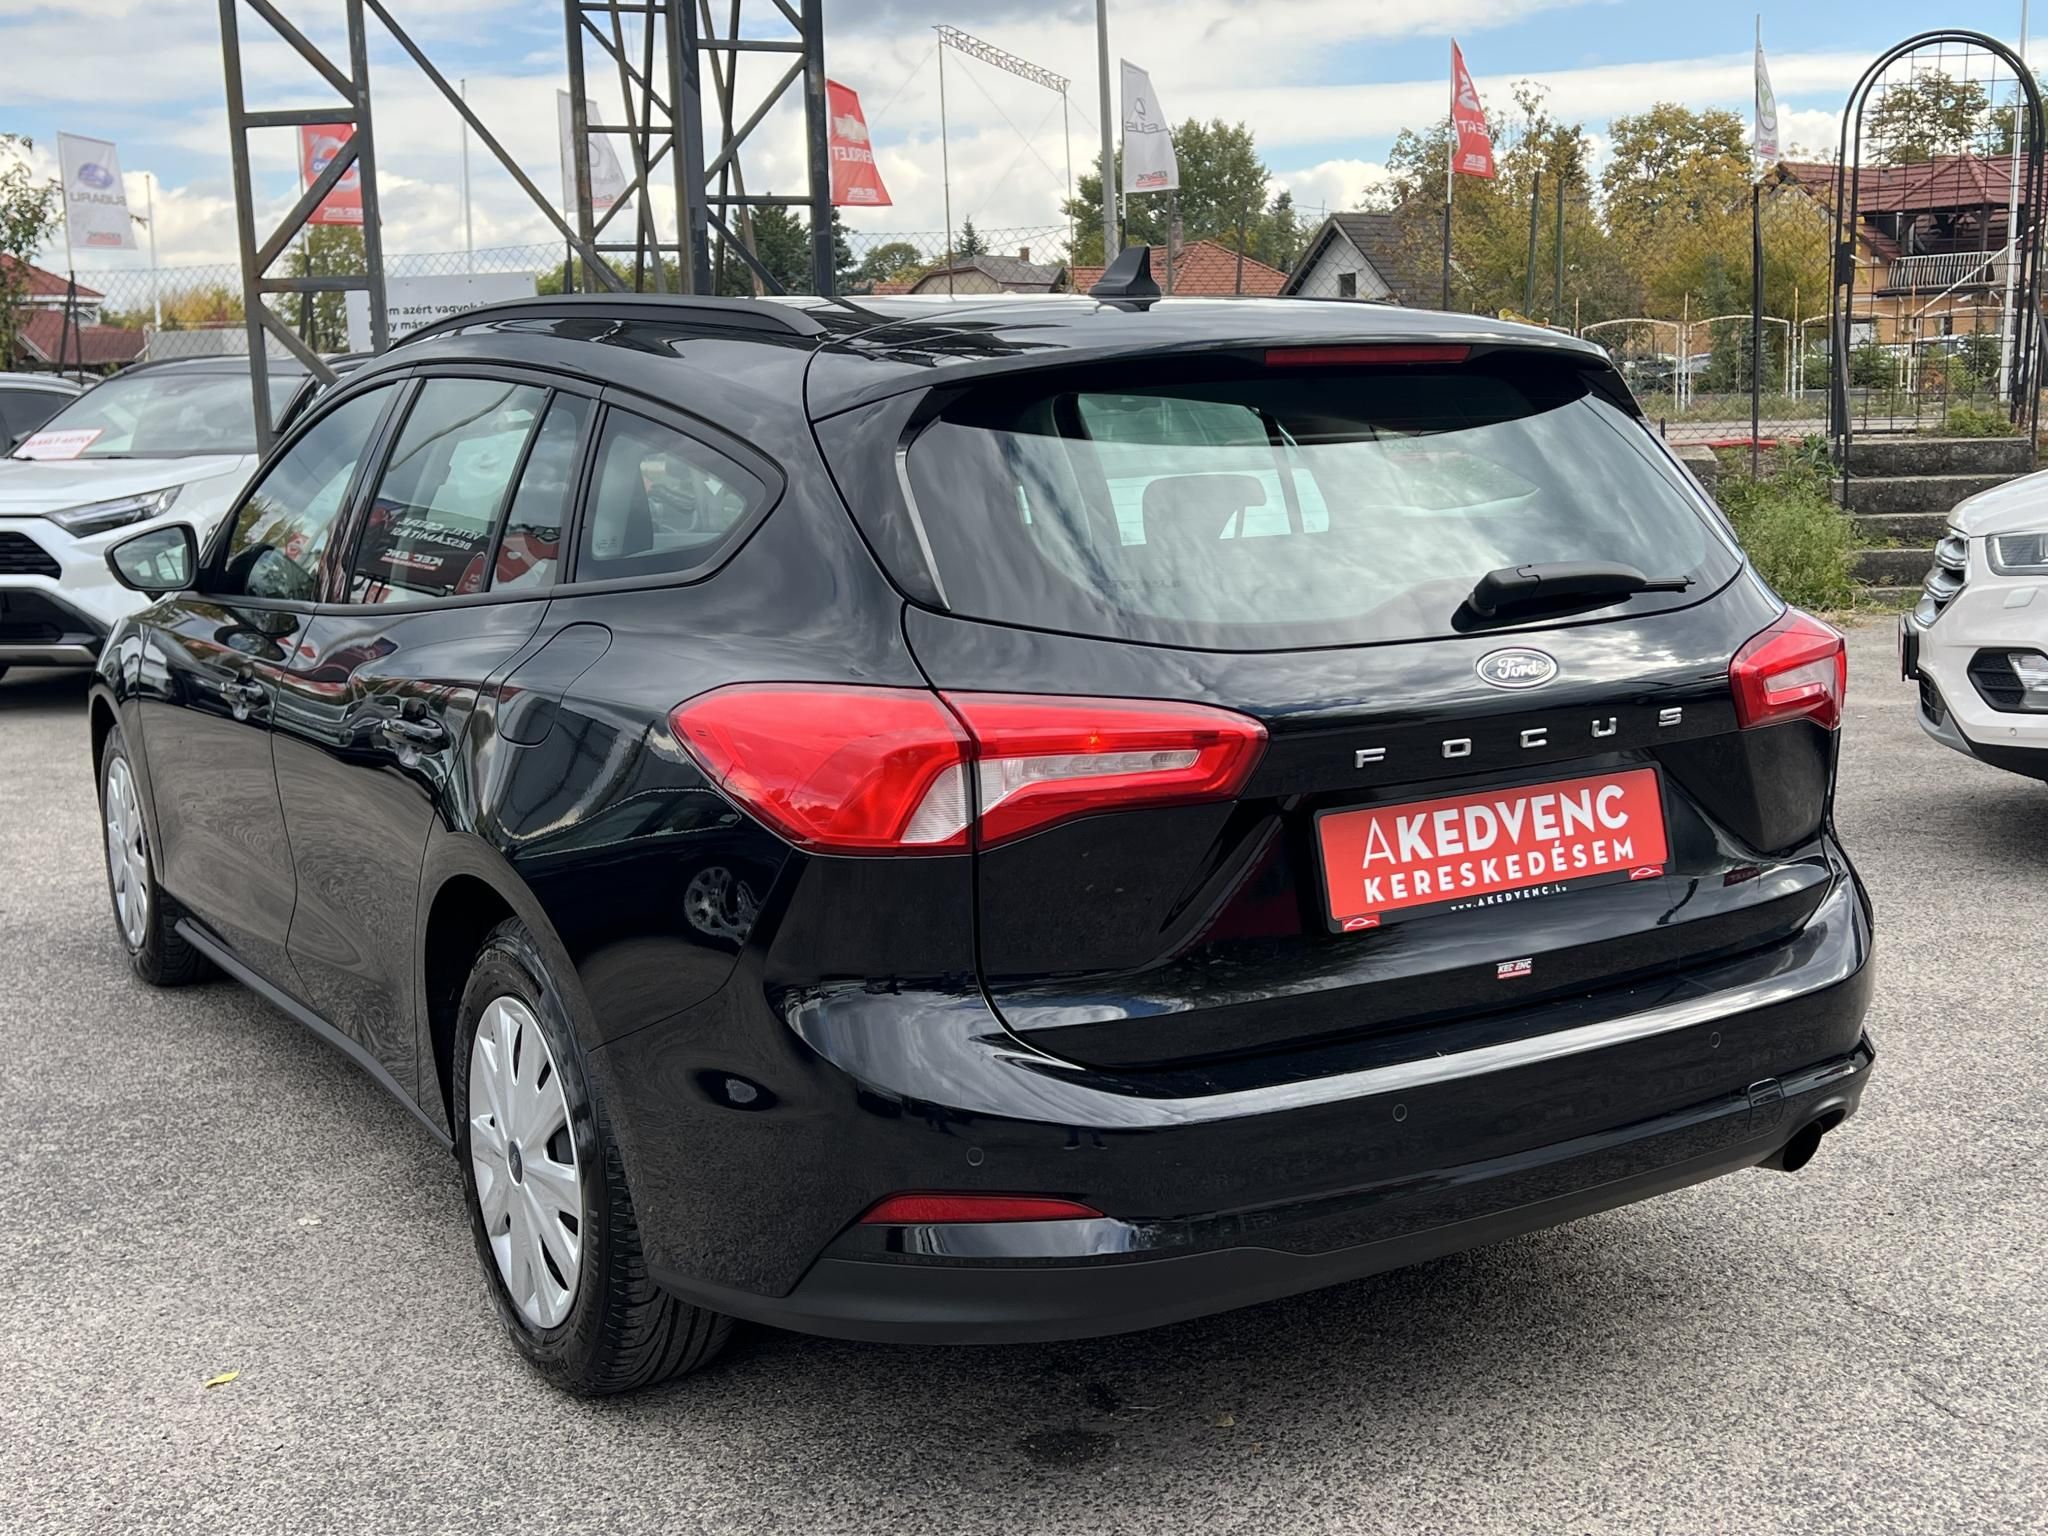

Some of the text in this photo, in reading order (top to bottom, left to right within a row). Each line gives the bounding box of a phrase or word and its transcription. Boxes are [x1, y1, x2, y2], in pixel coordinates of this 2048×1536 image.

[1497, 656, 1538, 679] Ford
[1354, 706, 1683, 769] FOCUS
[1363, 836, 1635, 904] KERESKEDÉSEM
